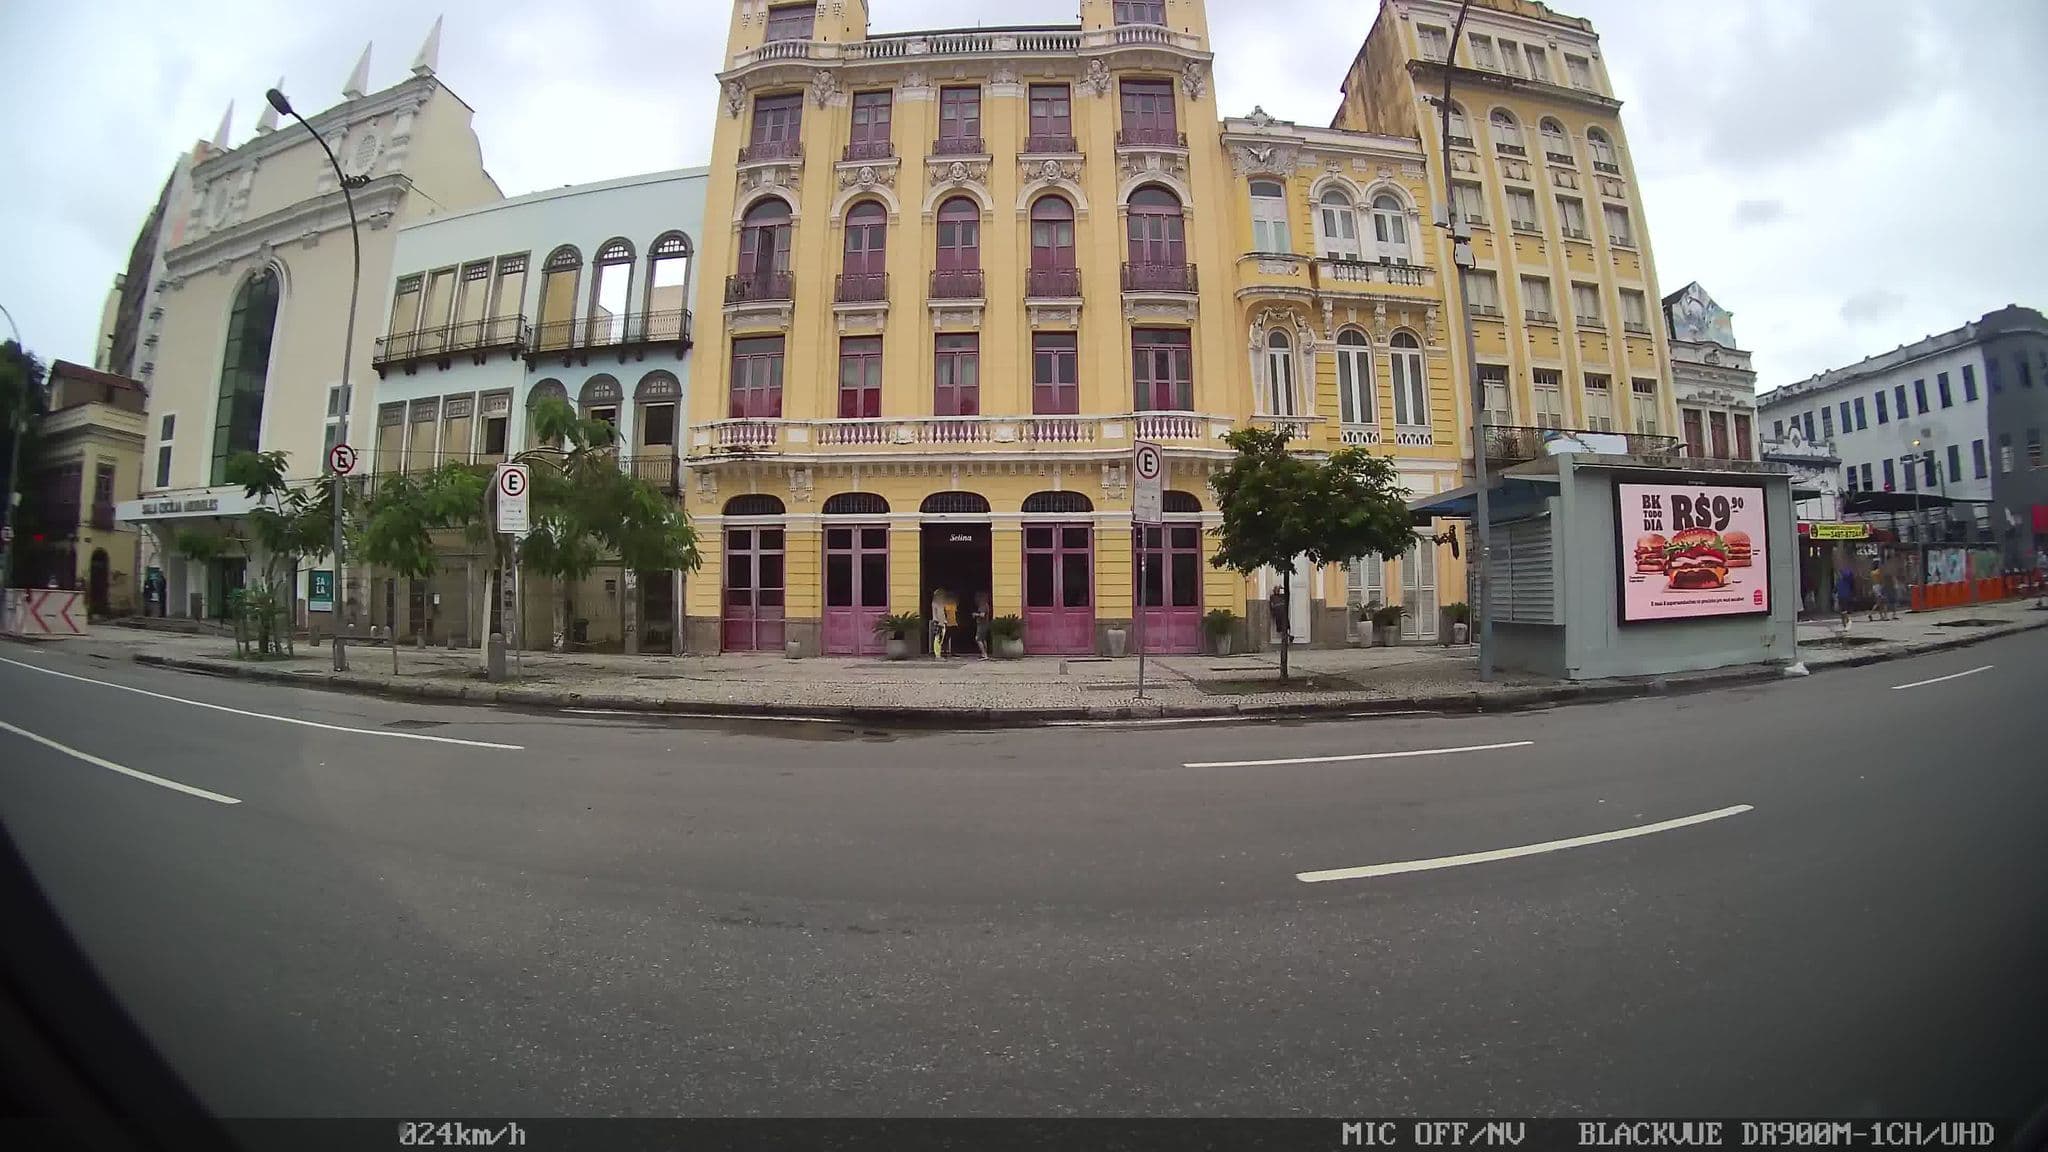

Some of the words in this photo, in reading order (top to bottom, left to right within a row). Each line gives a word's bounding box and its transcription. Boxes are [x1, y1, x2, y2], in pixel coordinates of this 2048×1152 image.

[1144, 454, 1153, 471] E
[509, 475, 518, 490] E
[1642, 494, 1662, 509] BK
[1643, 510, 1662, 518] TODO
[1643, 518, 1663, 531] DIA
[949, 533, 972, 542] Selina
